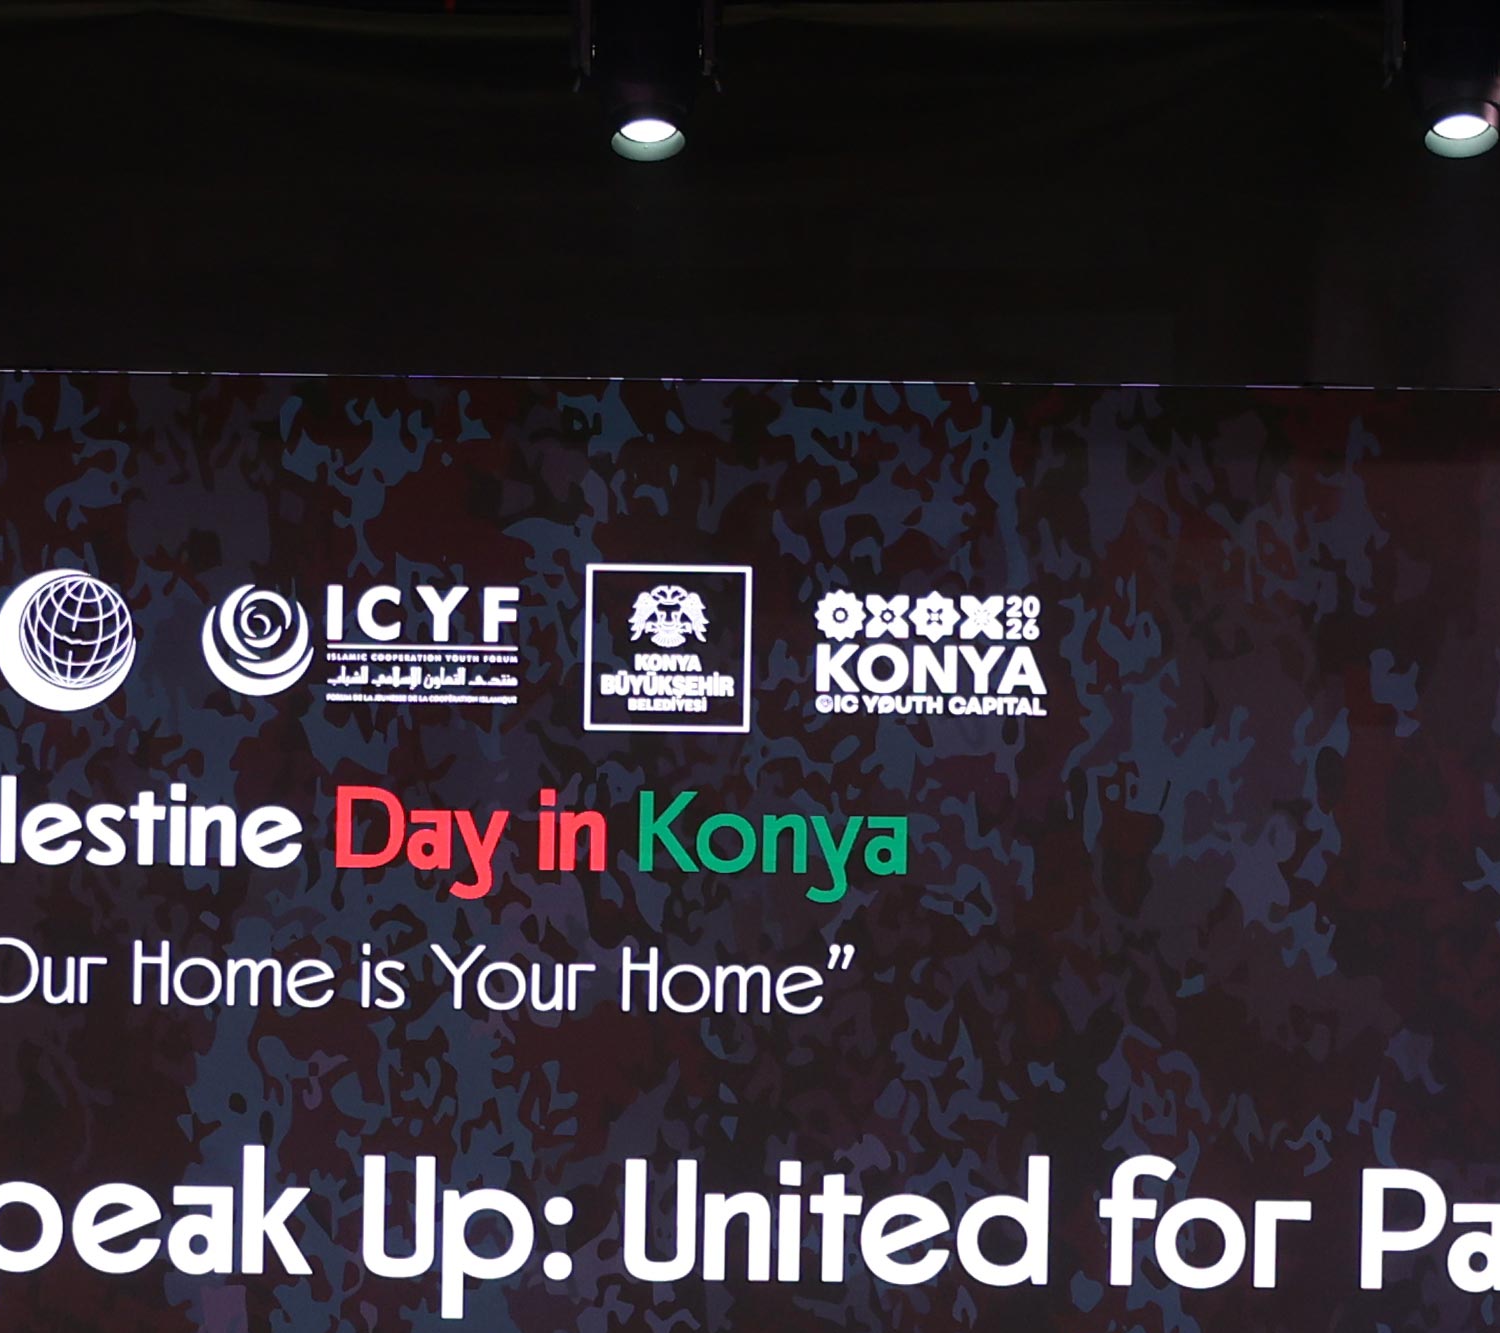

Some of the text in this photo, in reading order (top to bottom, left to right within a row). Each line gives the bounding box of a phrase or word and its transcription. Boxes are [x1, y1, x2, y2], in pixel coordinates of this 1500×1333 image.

[327, 585, 520, 642] ICYF
[1005, 595, 1041, 619] 20
[1005, 618, 1041, 641] 26
[327, 652, 519, 664] ISLAMIC COOPERATION YOUTH FORUM
[634, 653, 702, 673] KONYA
[815, 643, 1047, 695] KONYA
[600, 672, 735, 699] BÜYÜKŞEHİR
[628, 697, 708, 713] BELEDİYESİ
[863, 695, 943, 715] YOUTH
[948, 696, 1047, 717] CAPITAL
[336, 786, 510, 900] Day
[539, 789, 607, 872] in
[640, 792, 908, 903] Konya
[133, 940, 335, 1008] Home
[361, 943, 406, 1010] is
[431, 944, 597, 1012] Your
[363, 1155, 573, 1320] Up:
[624, 1156, 1050, 1287] United
[1100, 1155, 1312, 1289] for
